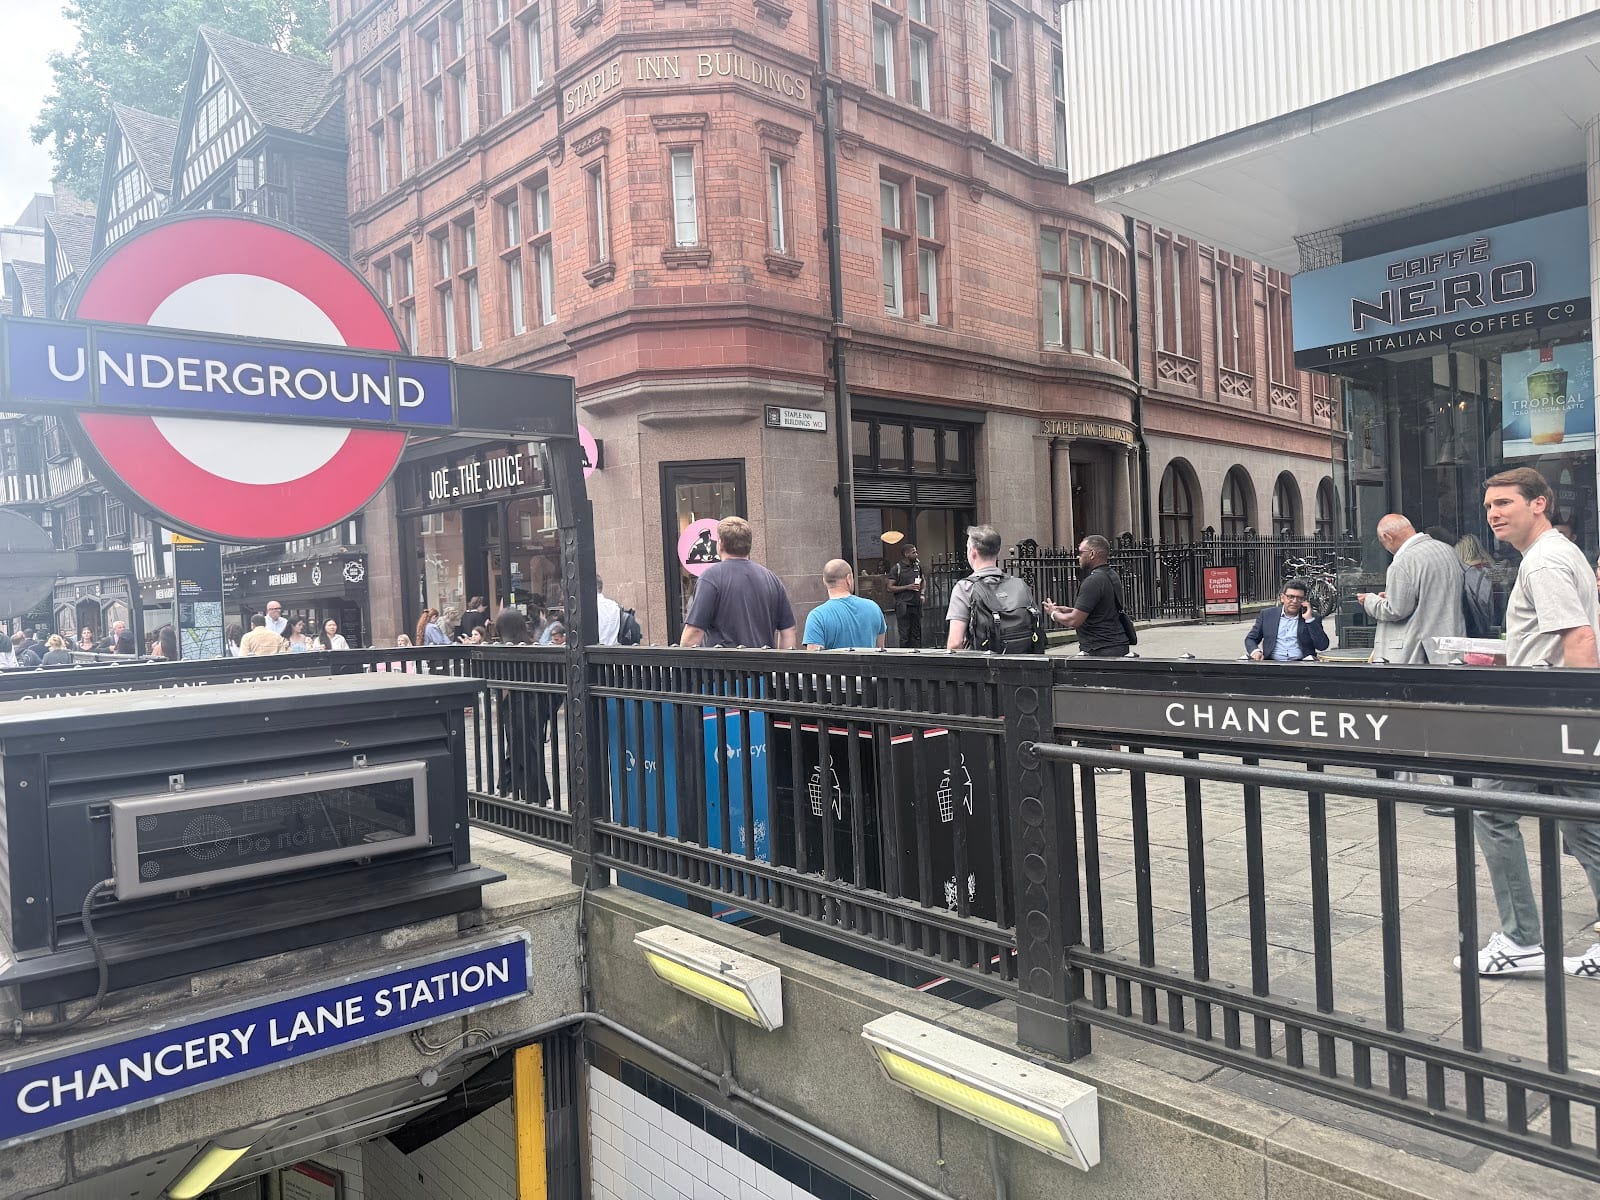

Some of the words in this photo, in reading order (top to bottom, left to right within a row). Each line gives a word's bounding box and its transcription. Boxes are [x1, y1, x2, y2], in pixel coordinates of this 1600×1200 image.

[566, 61, 622, 114] STAPLE
[635, 55, 681, 80] INN
[696, 52, 806, 101] BUILDINGS
[1386, 236, 1490, 282] CAFFÈ
[1350, 259, 1537, 333] NERO
[1327, 344, 1358, 360] THE
[1368, 327, 1443, 353] ITALIAN
[1453, 311, 1535, 338] COFFEE
[47, 343, 426, 409] UNDERGROUND
[1511, 393, 1585, 410] TROPICAL
[1044, 420, 1079, 435] STAPLE
[428, 468, 451, 500] JOE
[458, 462, 483, 496] THE
[486, 453, 525, 491] JUICE
[1164, 702, 1389, 741] CHANCERY
[237, 834, 271, 857] Do
[277, 823, 316, 849] not
[16, 1023, 257, 1115] CHANCERY
[268, 996, 367, 1048] LANE
[374, 956, 510, 1018] STATION
